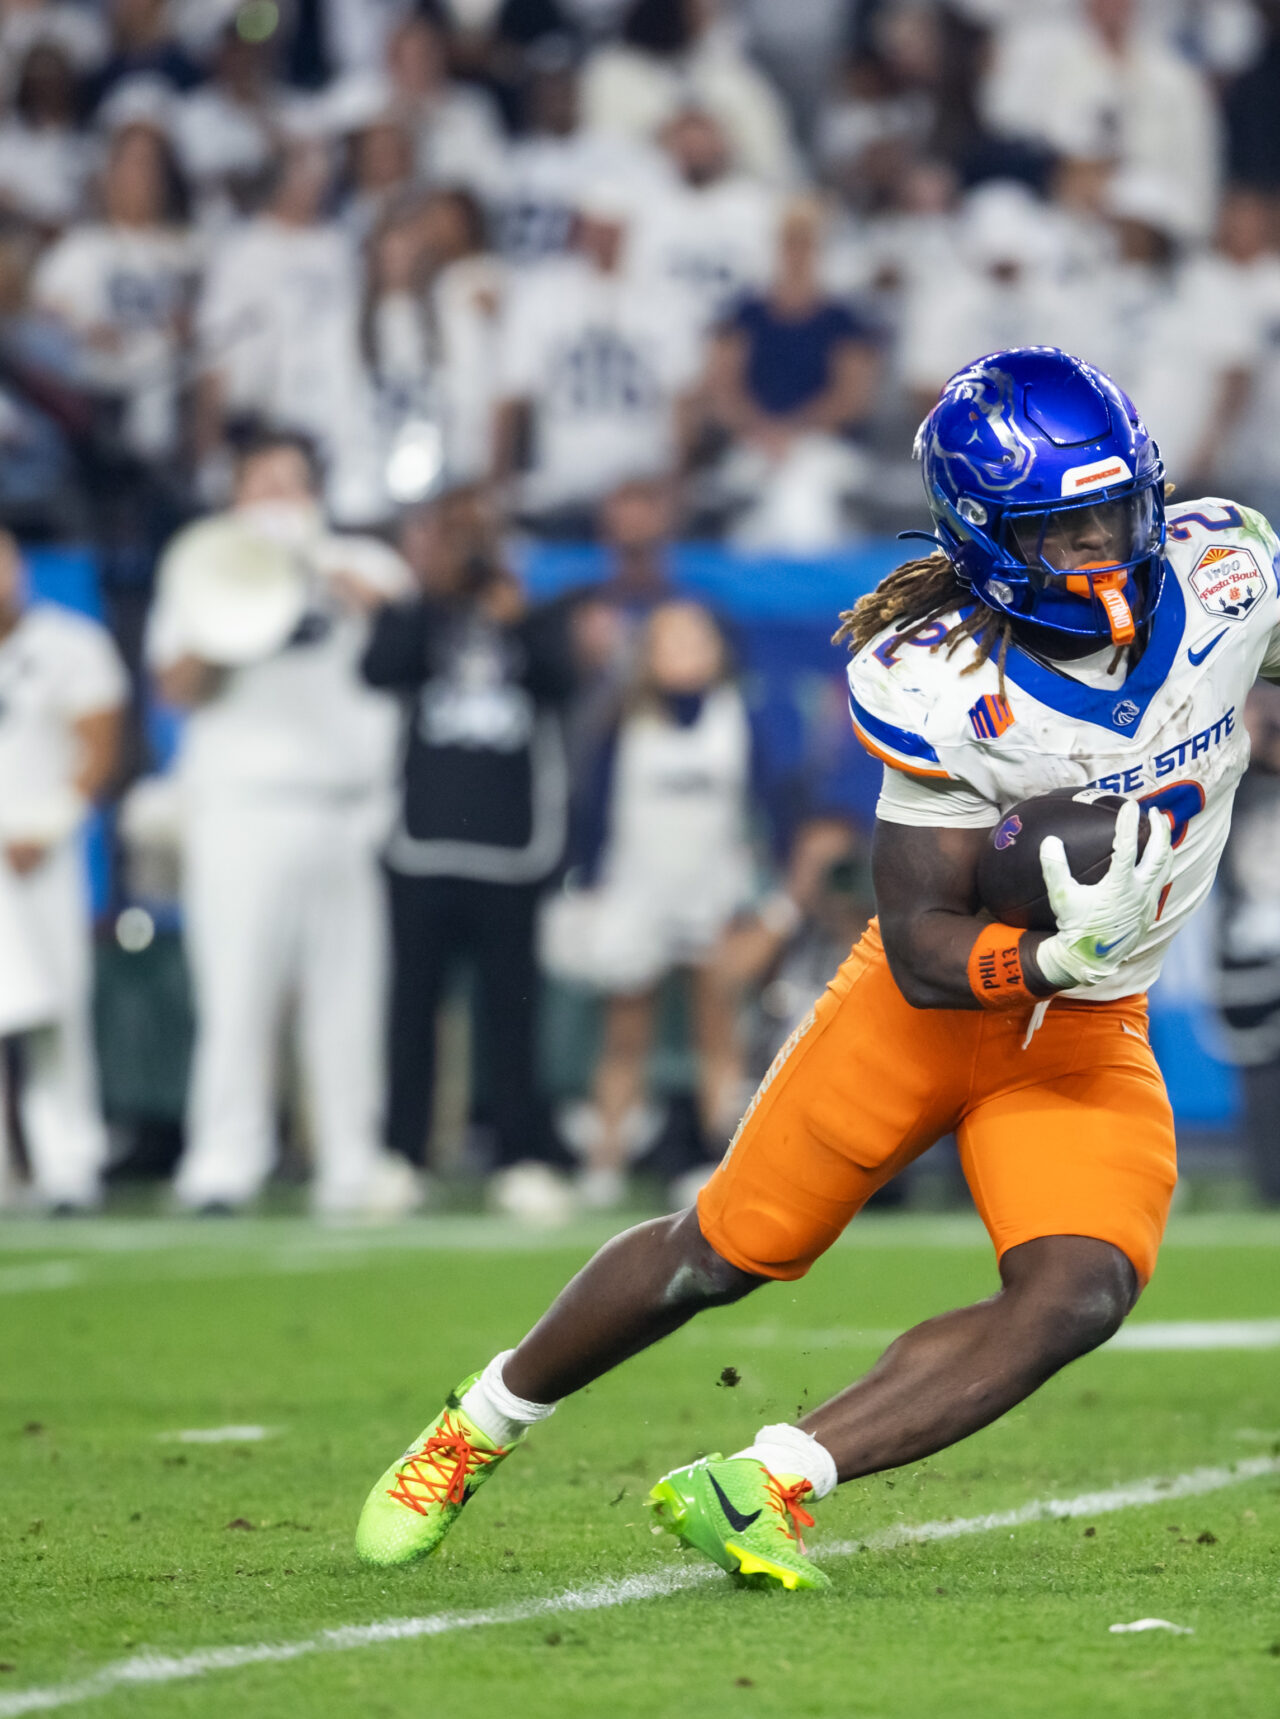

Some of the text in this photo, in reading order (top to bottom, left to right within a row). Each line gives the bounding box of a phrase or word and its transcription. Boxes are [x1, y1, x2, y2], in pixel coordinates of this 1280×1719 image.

[1168, 505, 1245, 541] 2
[1200, 569, 1259, 601] Fiesta Bowl
[1153, 706, 1236, 779] STATE
[979, 950, 1001, 989] PHIL
[1002, 947, 1021, 985] 4:13
